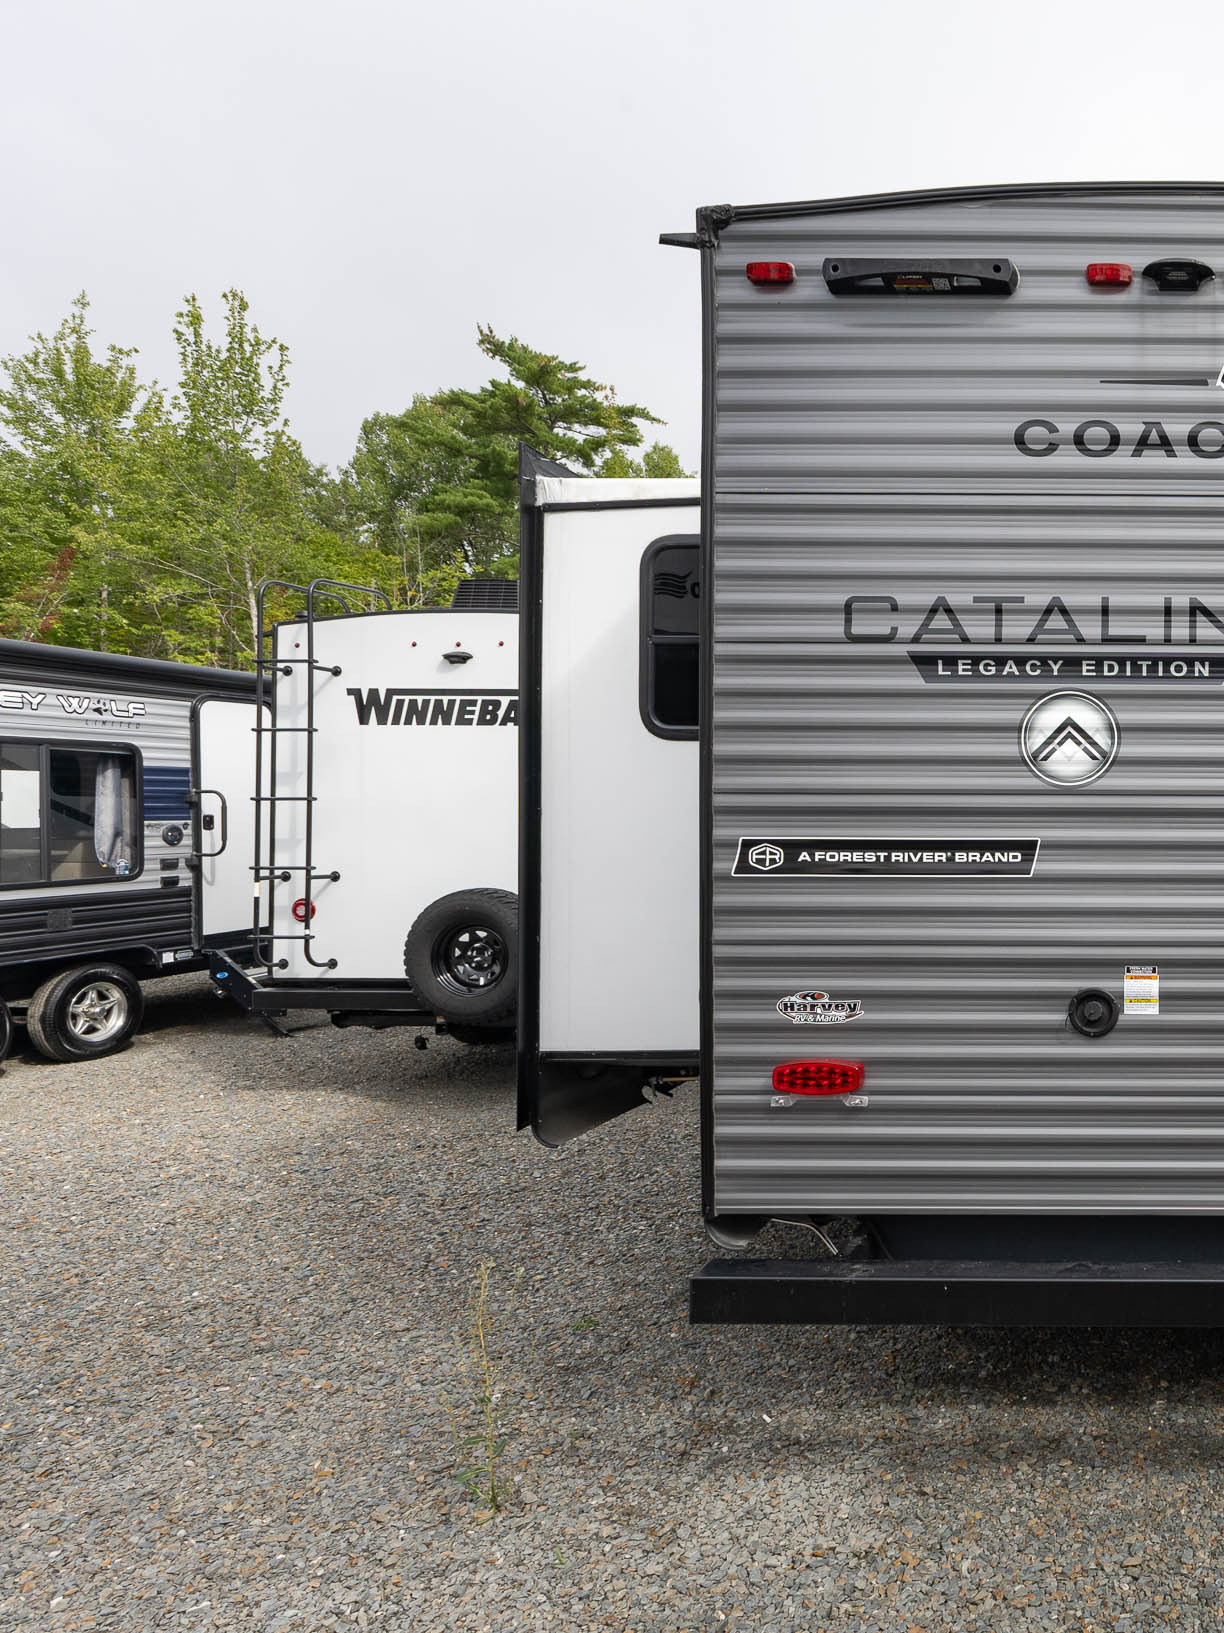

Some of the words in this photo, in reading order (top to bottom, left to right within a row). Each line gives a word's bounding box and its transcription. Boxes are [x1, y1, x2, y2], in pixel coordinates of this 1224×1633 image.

[937, 659, 1064, 676] LEGACY
[1082, 660, 1211, 677] EDITION
[56, 694, 147, 719] WLF
[346, 687, 520, 727] WINNEBA
[84, 718, 142, 730] LIMITED
[797, 851, 812, 863] A
[814, 851, 888, 863] FOREST
[954, 852, 1022, 863] BRAND
[782, 1001, 859, 1013] Harvey
[794, 1014, 807, 1022] RV
[816, 1014, 846, 1022] Marine
